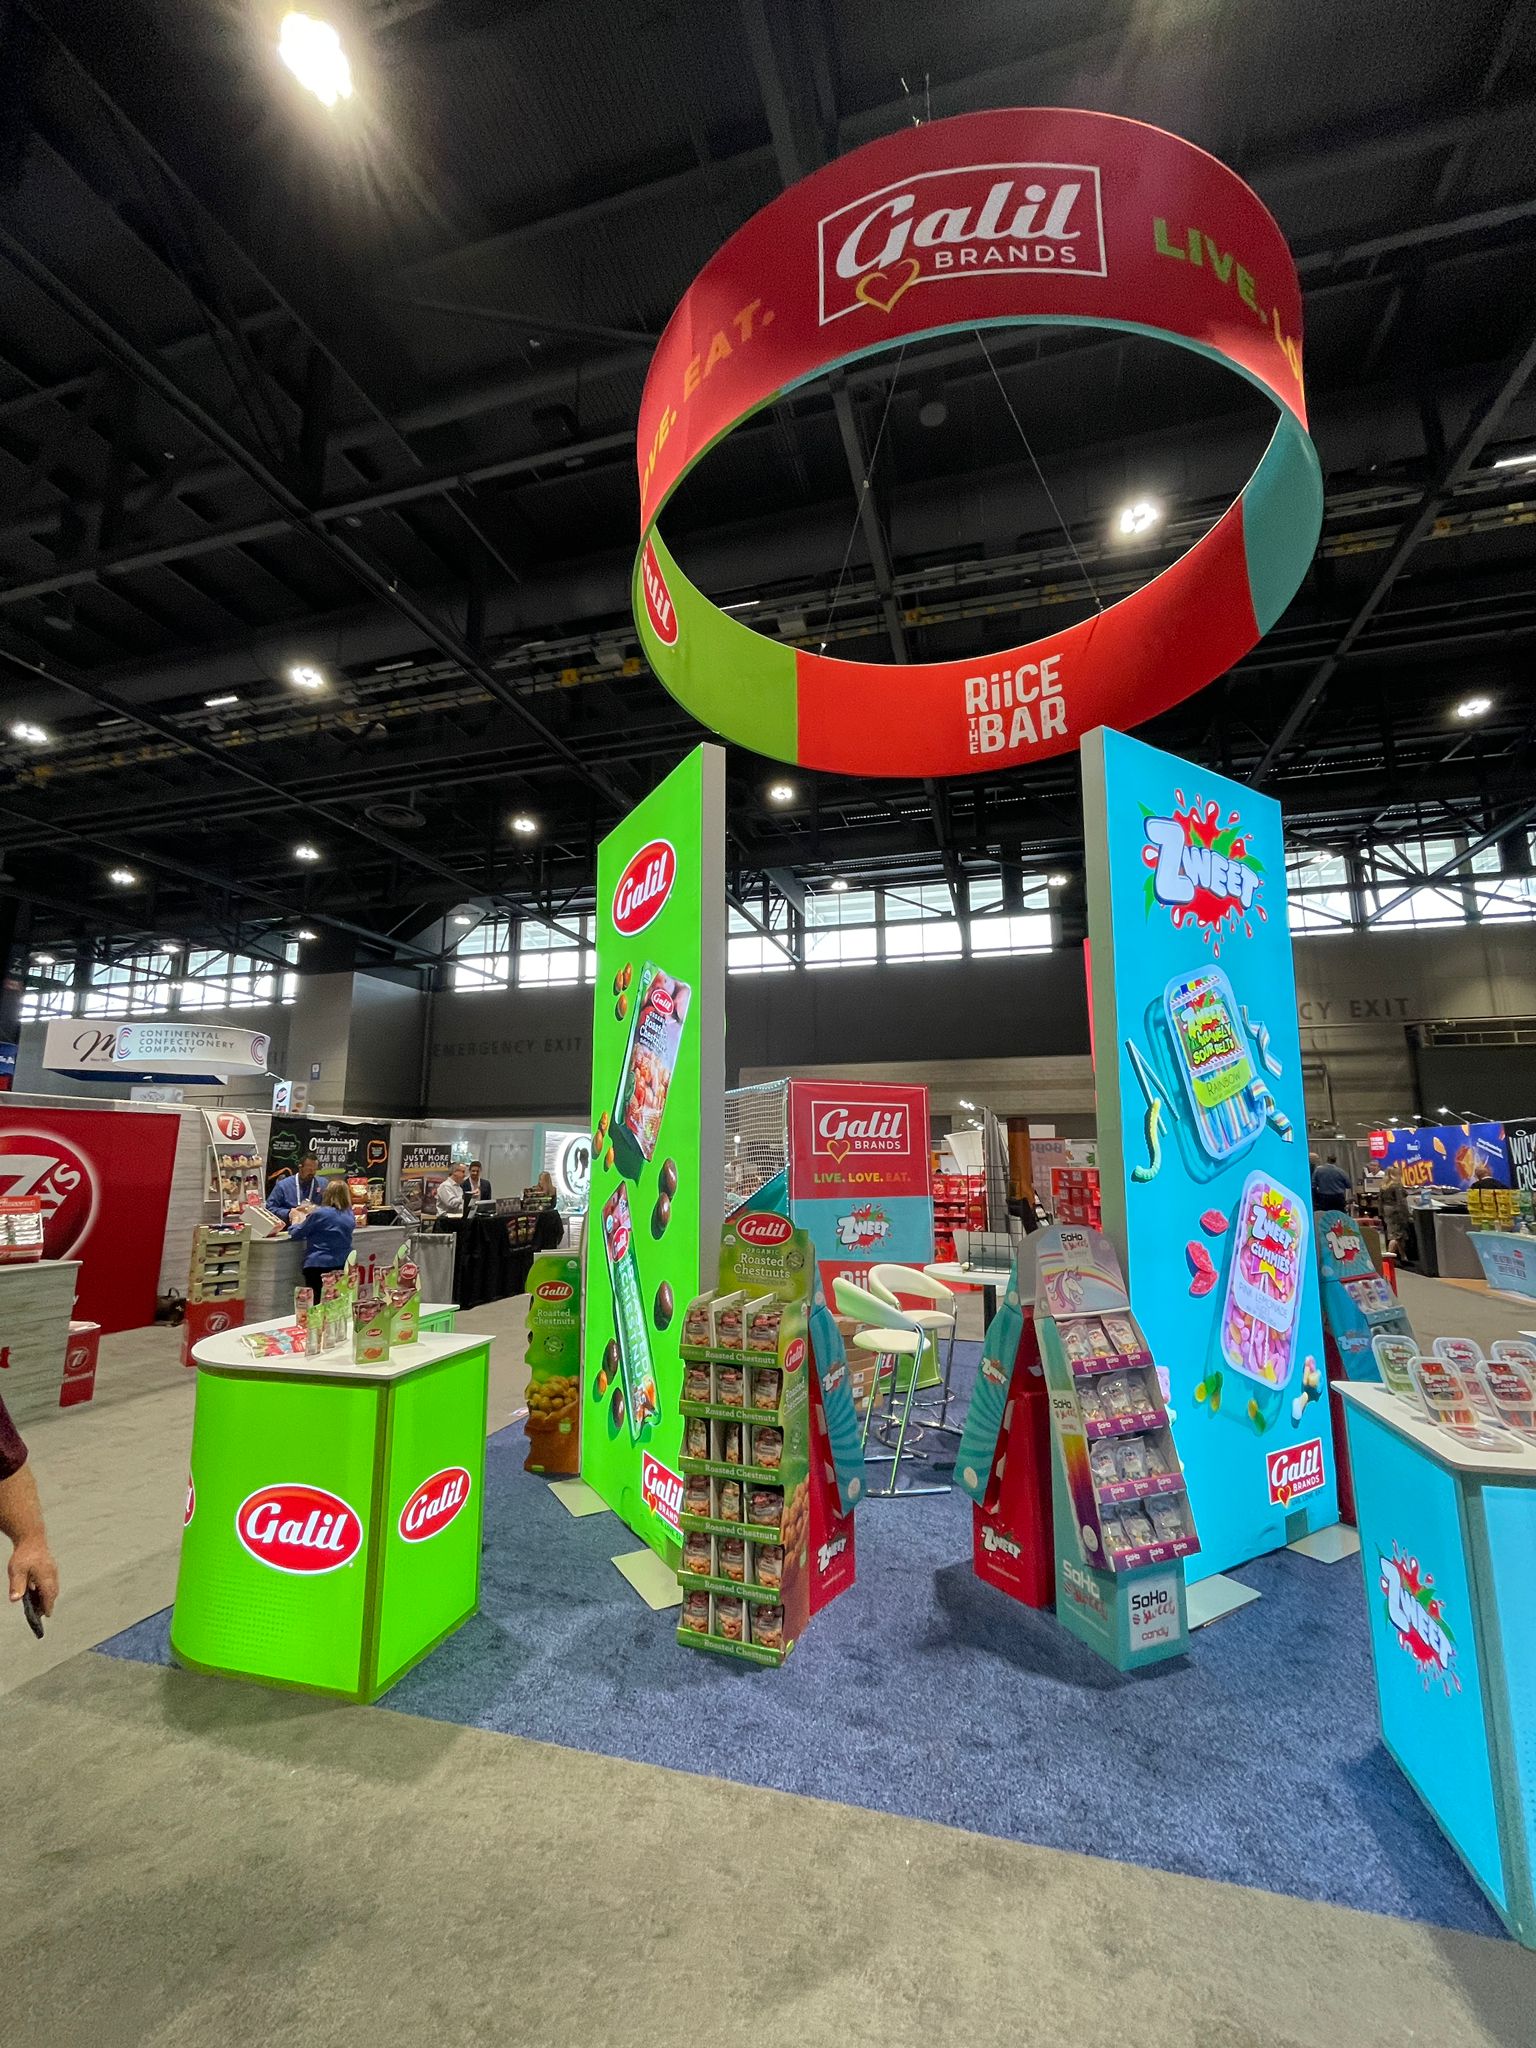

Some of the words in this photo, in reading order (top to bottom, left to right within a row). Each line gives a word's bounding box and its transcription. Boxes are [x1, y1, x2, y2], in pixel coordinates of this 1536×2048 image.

[836, 181, 1081, 279] Galil
[935, 245, 1076, 269] BRANDS
[1153, 218, 1268, 324] LIVE.
[684, 299, 775, 403] EAT.
[979, 696, 1068, 754] BAR
[968, 717, 979, 755] THE
[616, 850, 667, 921] Galil
[653, 992, 671, 1011] Galil
[1351, 998, 1408, 1018] EXIT
[139, 1038, 234, 1049] CONFECTIONERY
[140, 1030, 219, 1040] CONTINENTAL
[138, 1046, 195, 1054] COMPANY
[433, 1040, 534, 1057] EMERGENCY
[544, 1037, 582, 1053] EXIT
[819, 1109, 903, 1140] Galil
[854, 1140, 901, 1150] BRANDS
[814, 1172, 846, 1183] LIVE.
[848, 1172, 884, 1183] LOVE.
[741, 1220, 786, 1240] Galil
[741, 1253, 784, 1266] Roasted
[1251, 1242, 1290, 1275] GUMMIES
[734, 1264, 791, 1278] Chestnuts
[538, 1285, 570, 1297] Galil
[534, 1317, 575, 1326] Chestnuts
[537, 1309, 571, 1317] Roasted
[705, 1351, 734, 1361] Roasted
[736, 1353, 775, 1364] Chestnuts
[705, 1407, 734, 1418] Roasted
[736, 1409, 775, 1422] Chestnuts
[705, 1465, 734, 1475] Roasted
[736, 1468, 776, 1481] Chestnuts
[1271, 1445, 1320, 1487] Galil
[644, 1464, 684, 1514] Galil
[1293, 1475, 1320, 1492] BRANDS
[405, 1475, 465, 1532] Galil
[658, 1500, 679, 1524] BRAND
[246, 1502, 348, 1551] Galil
[705, 1523, 735, 1533] Roasted
[737, 1527, 777, 1540] Chestnuts
[704, 1580, 735, 1593] Roasted
[736, 1587, 777, 1601] Chestnuts
[1132, 1590, 1167, 1610] SoHo
[1142, 1627, 1169, 1640] candy
[704, 1639, 735, 1652] Roasted
[736, 1646, 777, 1663] Chestnuts
